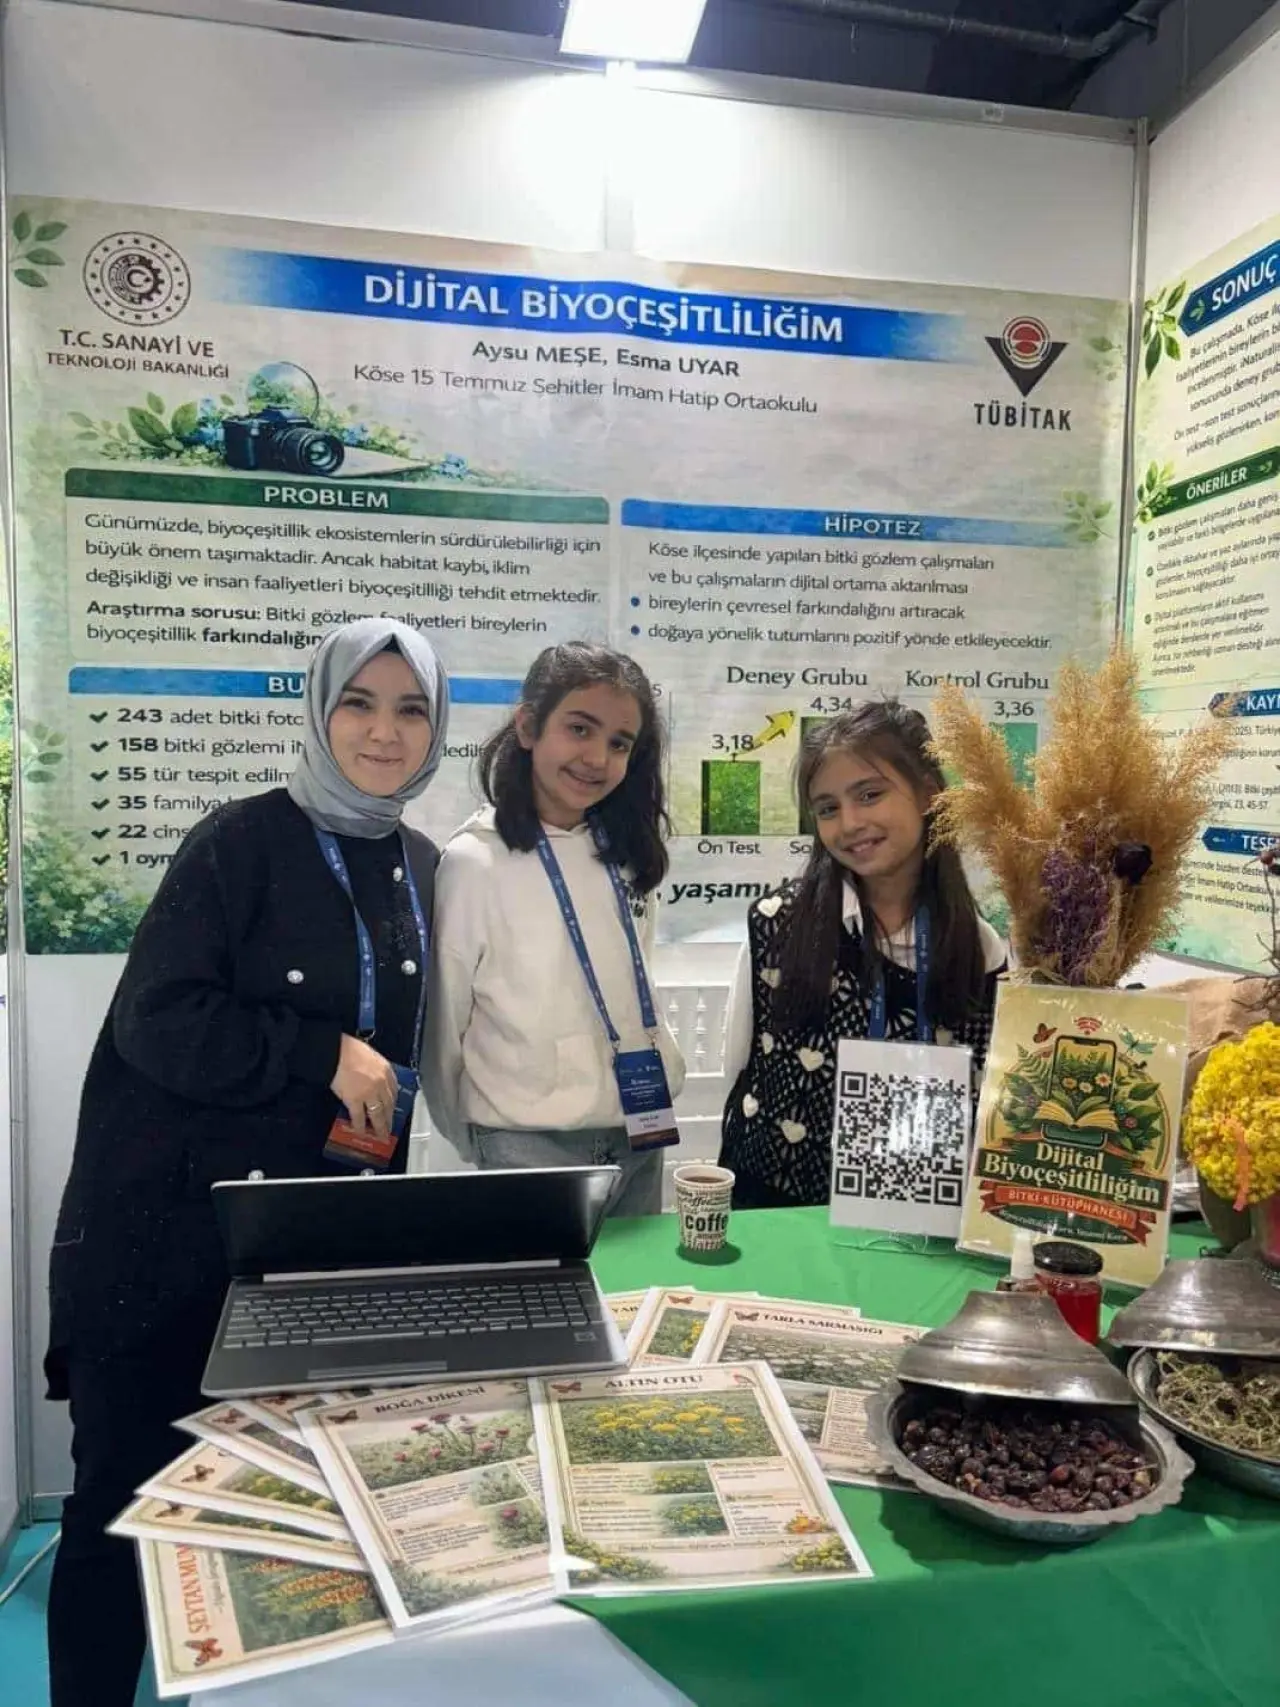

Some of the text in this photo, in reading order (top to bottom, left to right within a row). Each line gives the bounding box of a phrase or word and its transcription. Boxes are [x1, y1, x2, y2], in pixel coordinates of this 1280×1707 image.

[1210, 253, 1279, 312] SONUÇ
[364, 270, 845, 343] DİJİTAL BİYOÇEŞİTLİLİĞİM
[59, 329, 214, 358] T.C. SANAYİ VE
[47, 352, 229, 379] TEKNOLOJİ BAKANLIĞI
[472, 341, 741, 377] Aysu MEŞE, Esma UYAR
[354, 365, 404, 384] Köse
[411, 369, 435, 386] 15
[440, 371, 526, 393] Temmuz
[612, 378, 664, 403] İmam
[669, 389, 719, 411] Hatip
[724, 392, 818, 414] Ortaokulu
[974, 399, 1072, 431] TÜBİTAK
[1186, 466, 1248, 500] ÖNERİLER
[264, 486, 389, 509] PROBLEM
[85, 513, 203, 535] Günümüzde,
[316, 527, 435, 546] ekosistemlerin
[440, 534, 568, 555] sürdürülebilirliği
[574, 540, 602, 554] için
[824, 514, 921, 537] HİPOTEZ
[85, 540, 143, 560] büyük
[148, 543, 202, 560] önem
[322, 551, 375, 567] Ancak
[380, 554, 440, 571] habitat
[493, 559, 530, 575] iklim
[649, 542, 689, 557] Köse
[766, 549, 821, 565] yapılan
[826, 549, 858, 563] bitki
[862, 551, 916, 569] gözlem
[85, 568, 173, 589] değişikliği
[178, 575, 199, 586] ve
[204, 573, 249, 590] insan
[254, 575, 343, 594] faaliyetleri
[459, 586, 506, 601] tehdit
[510, 588, 602, 604] etmektedir.
[649, 571, 667, 583] ve
[671, 569, 692, 584] bu
[789, 573, 829, 592] dijital
[833, 578, 888, 592] ortama
[87, 600, 185, 619] Araştırma
[191, 605, 260, 620] sorusu:
[266, 606, 306, 622] Bitki
[381, 611, 466, 631] aliyetleri
[471, 615, 547, 634] bireylerin
[649, 594, 966, 620] bireylerin çevresel farkındalığını artıracak
[648, 624, 703, 642] doğaya
[708, 627, 764, 643] yönelik
[853, 631, 901, 647] pozitif
[904, 633, 950, 648] yönde
[727, 666, 868, 688] Deney Grubu
[987, 671, 1049, 690] Grubu
[117, 709, 163, 723] 243
[170, 708, 213, 725] adet
[219, 709, 261, 726] bitki
[810, 697, 852, 712] 4,34
[994, 701, 1035, 719] 3,36
[119, 738, 158, 752] 158
[165, 738, 206, 753] bitki
[211, 738, 287, 757] gözlemi
[711, 734, 755, 751] 3,18
[118, 767, 147, 781] 55
[154, 768, 181, 782] tür
[187, 768, 240, 786] tespit
[118, 796, 148, 809] 35
[118, 825, 148, 839] 22
[119, 852, 129, 865] 1
[698, 839, 761, 854] Ön Test
[1035, 1143, 1105, 1171] Dijital
[984, 1152, 1160, 1205] Biyoçeşitliliğim
